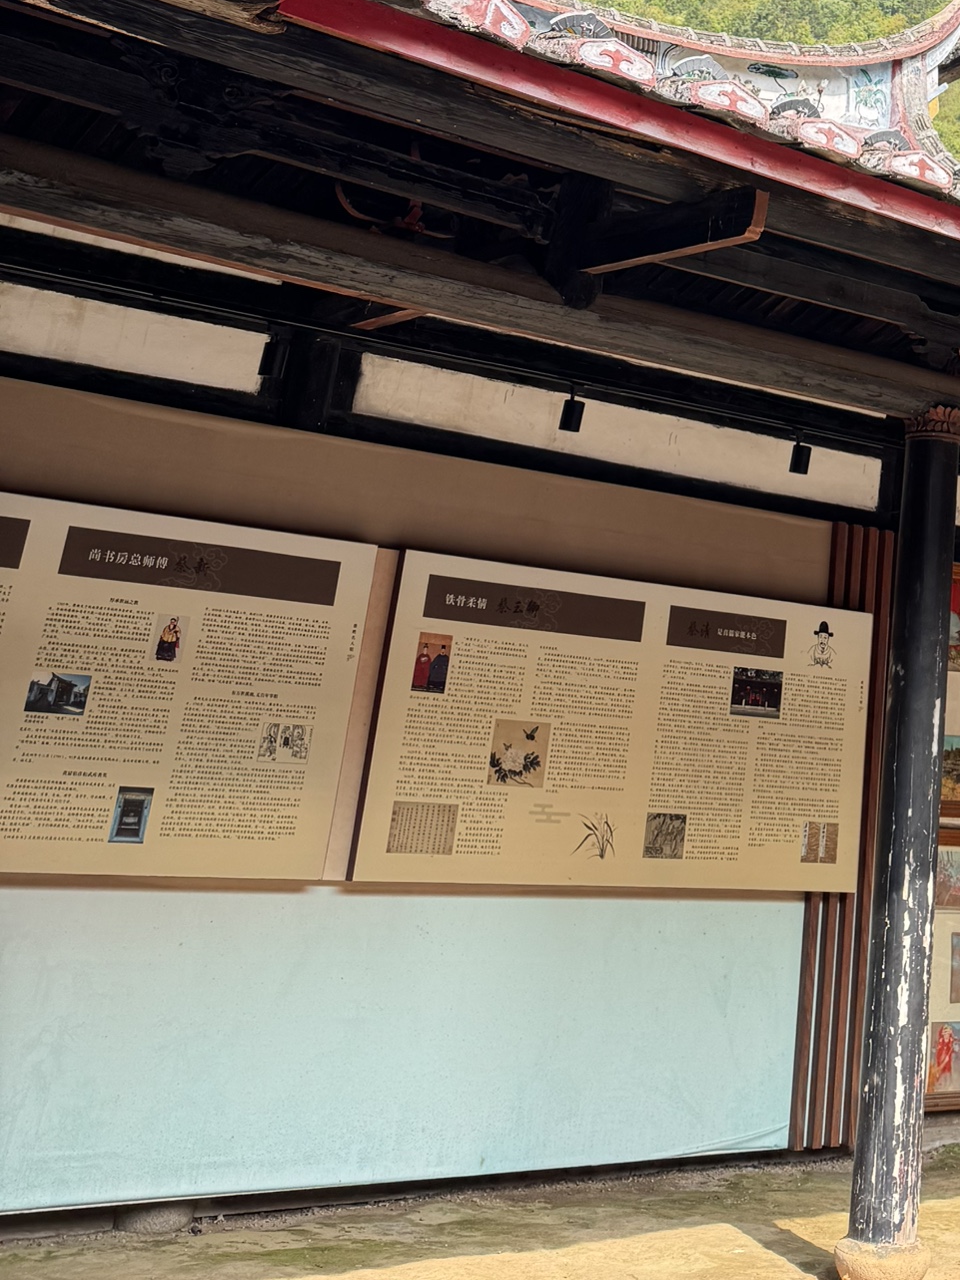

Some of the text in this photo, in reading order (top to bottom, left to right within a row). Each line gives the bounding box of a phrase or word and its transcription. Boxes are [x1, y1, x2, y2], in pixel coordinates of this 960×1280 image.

[88, 548, 169, 570] 尚书房总师傅
